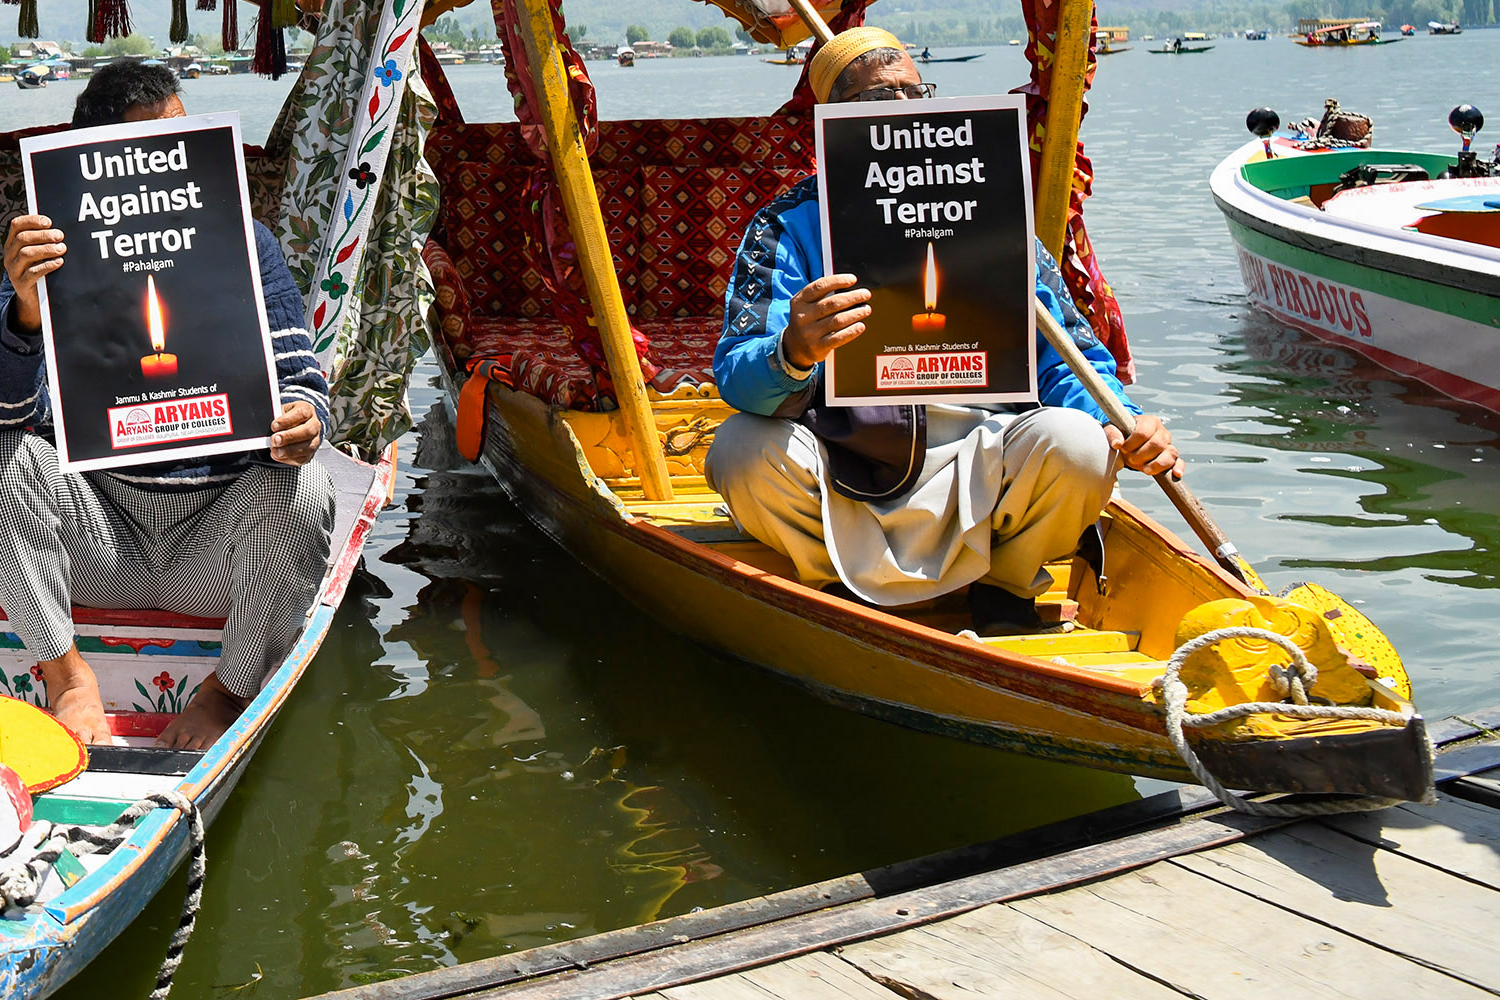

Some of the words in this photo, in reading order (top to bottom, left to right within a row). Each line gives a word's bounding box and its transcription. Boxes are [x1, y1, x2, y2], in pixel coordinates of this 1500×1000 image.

[869, 119, 973, 151] United
[79, 140, 188, 181] United
[865, 157, 985, 193] Against
[77, 181, 203, 225] Against
[876, 198, 977, 224] Terror
[91, 226, 196, 260] Terror
[904, 227, 954, 240] #Pahalgam
[122, 258, 174, 273] #Pahalgam
[1267, 263, 1372, 337] FIRDOUS
[884, 345, 906, 353] Jammu
[942, 342, 970, 351] Students
[881, 366, 915, 380] ARYANS
[917, 355, 983, 372] ARYANS
[115, 395, 140, 405] Jammu
[142, 393, 148, 401] &
[149, 389, 177, 400] Kashmir
[178, 386, 208, 397] Students
[210, 383, 217, 393] of
[155, 399, 225, 424] ARYANS
[117, 421, 153, 437] ARYANS
[155, 424, 179, 433] GROUP
[192, 418, 226, 428] COLLEGES
